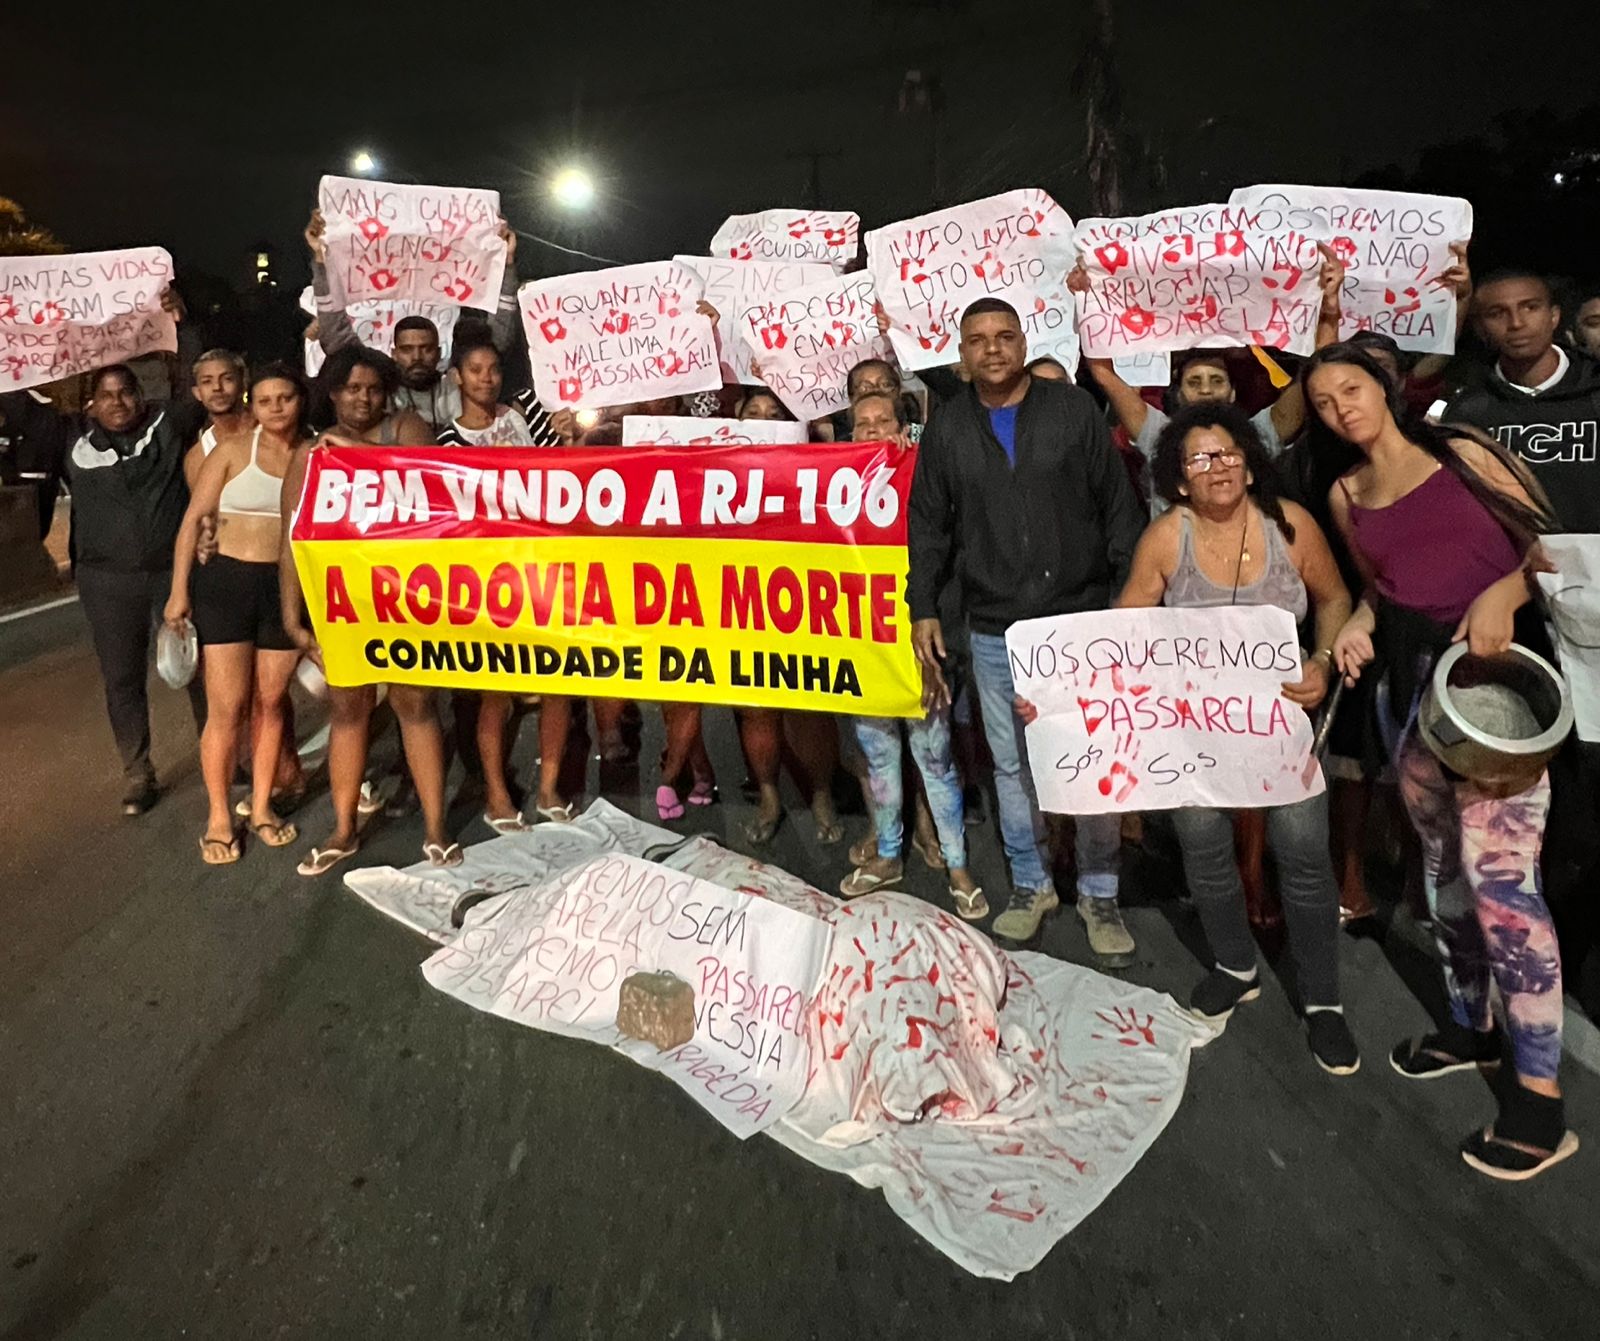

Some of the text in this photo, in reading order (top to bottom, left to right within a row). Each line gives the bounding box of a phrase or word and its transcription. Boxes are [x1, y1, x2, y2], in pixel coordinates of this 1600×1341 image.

[760, 238, 841, 260] CUIDADO
[889, 214, 1036, 267] LUTO LUTO
[1367, 236, 1430, 270] NÃO
[99, 256, 168, 281] VIDAS
[348, 267, 451, 294] LTO
[902, 258, 1045, 311] LUTO LUTO
[618, 336, 663, 357] UMA
[916, 307, 1063, 341] LUT UTO
[312, 466, 899, 528] BEM VINDO A RJ-106
[326, 561, 897, 644] A RODOVIA DA MORTE
[364, 638, 863, 698] COMUNIDADE DA LINHA
[1010, 630, 1297, 680] NÓS QUEREMOS
[1080, 695, 1292, 737] PASSARELA
[667, 902, 747, 952] SEM
